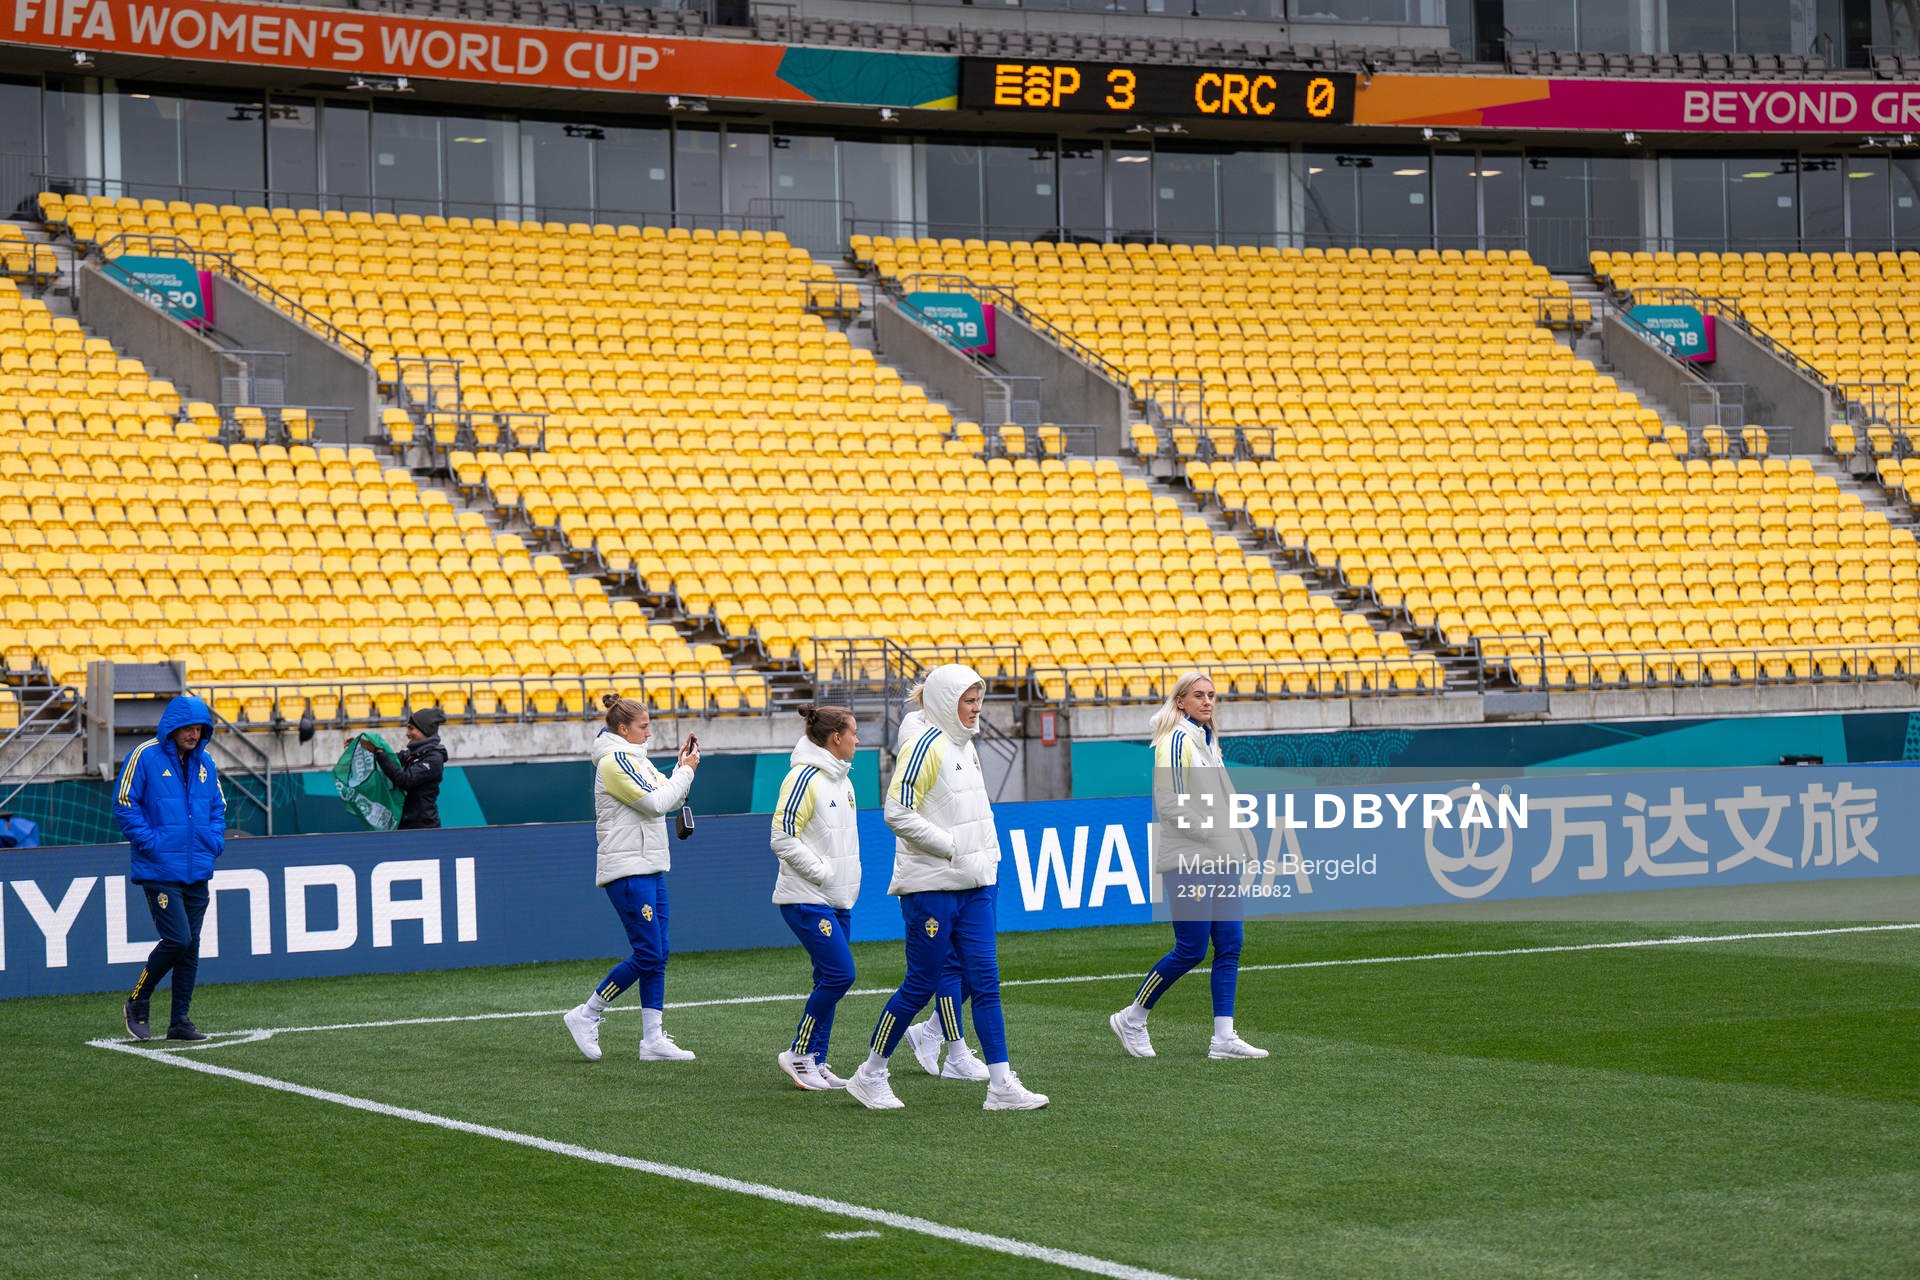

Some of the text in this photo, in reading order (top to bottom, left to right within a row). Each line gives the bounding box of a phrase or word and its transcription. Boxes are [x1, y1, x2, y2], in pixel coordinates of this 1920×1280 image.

[14, 0, 116, 41] FIFA
[128, 4, 364, 61] WOMEN'S
[380, 26, 548, 75] WORLD
[1106, 69, 1136, 110] 3
[1195, 73, 1277, 115] CRC
[1306, 78, 1335, 117] 0
[1684, 90, 1858, 124] BEYOND
[168, 290, 197, 309] 20
[957, 322, 978, 337] 19
[1679, 331, 1698, 346] 18
[1528, 781, 1879, 884] 万达文旅
[0, 857, 478, 971] YUNDAI
